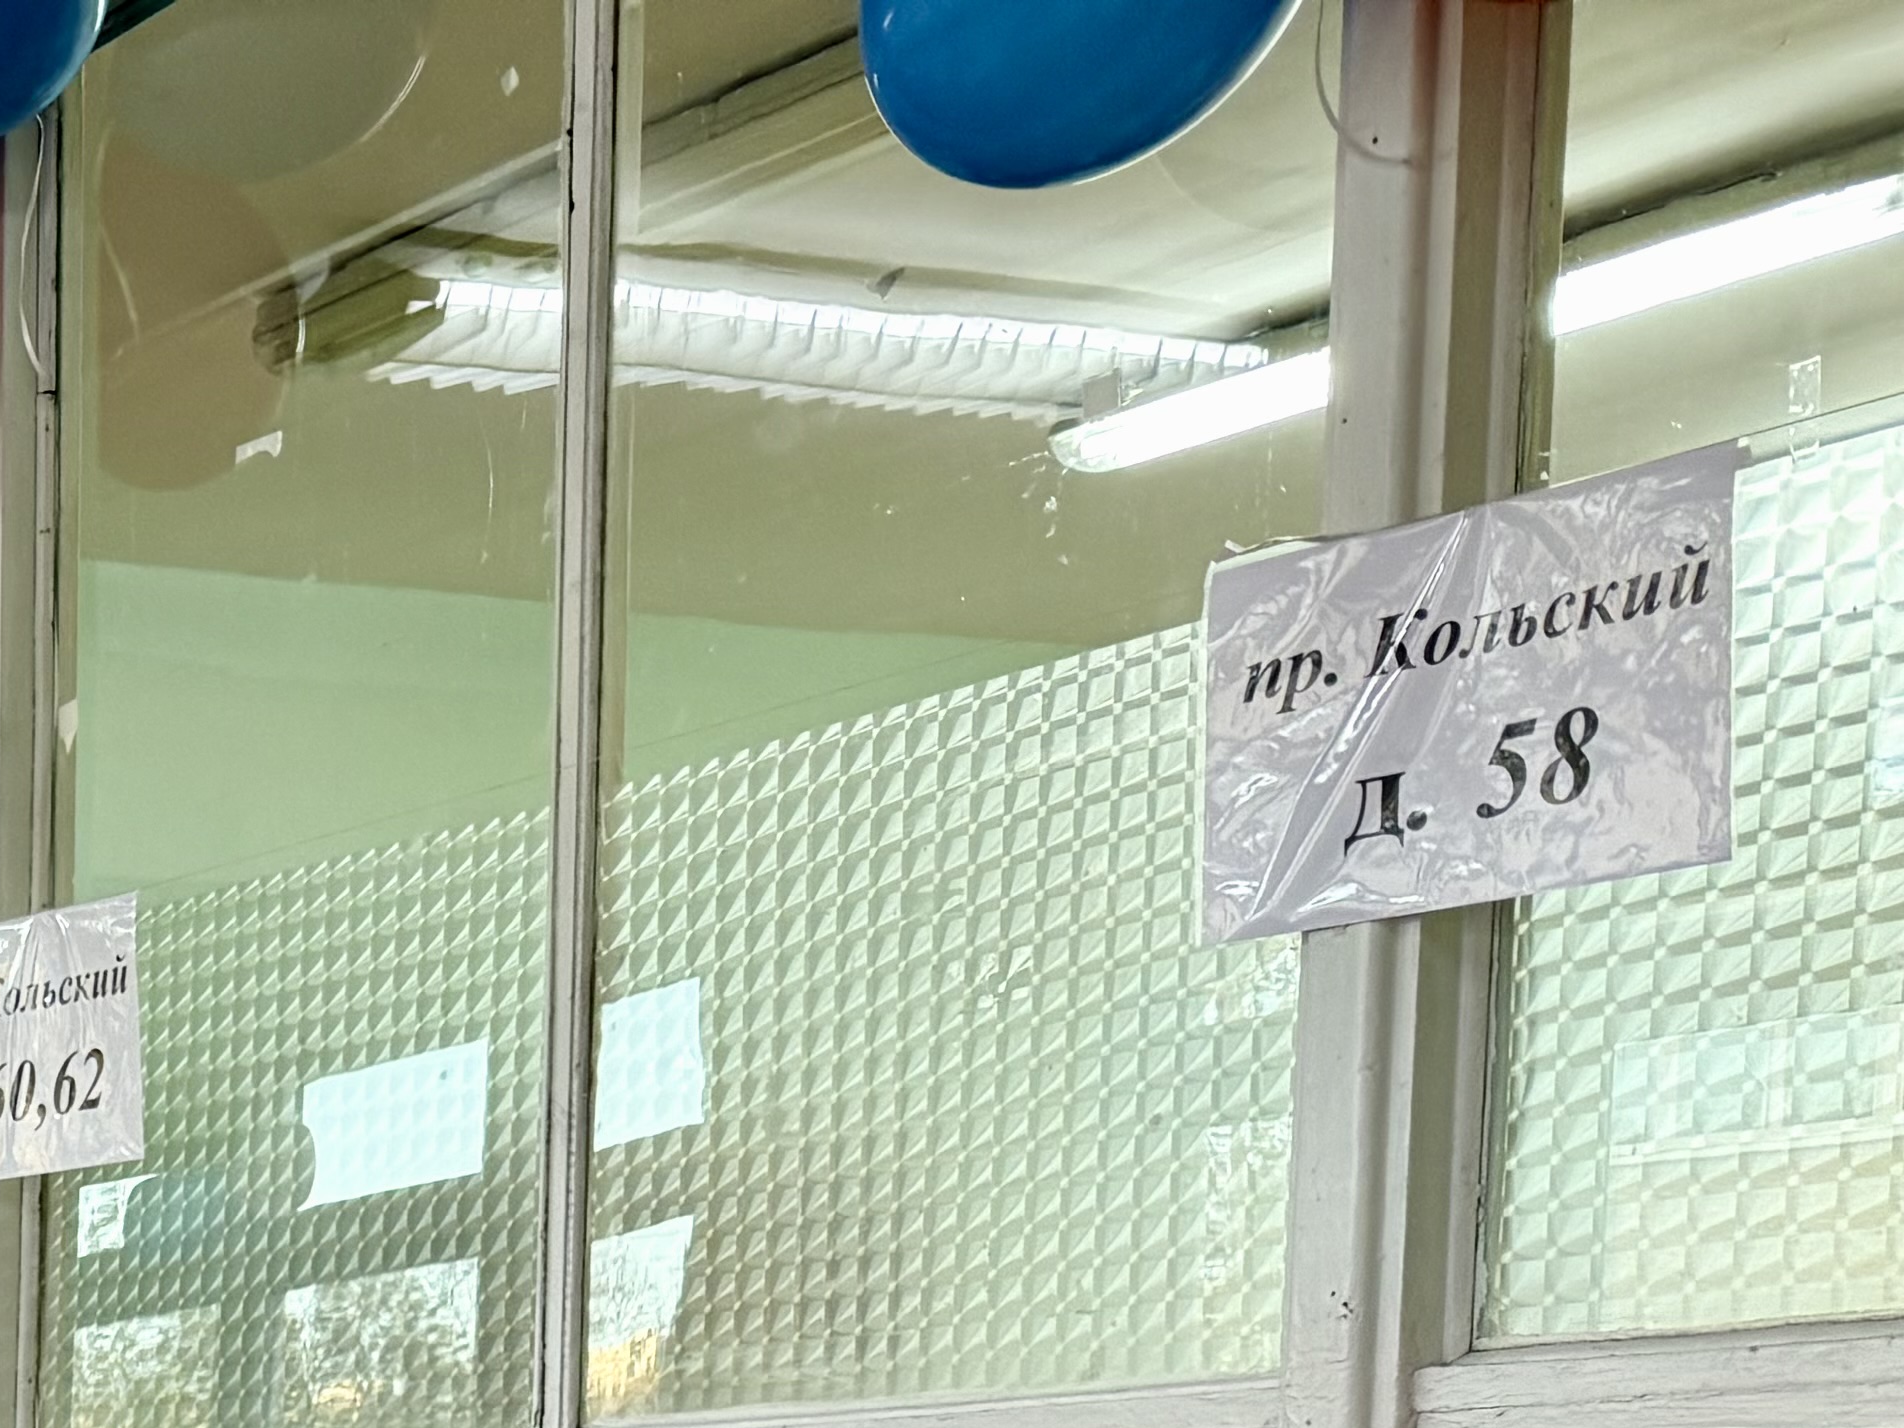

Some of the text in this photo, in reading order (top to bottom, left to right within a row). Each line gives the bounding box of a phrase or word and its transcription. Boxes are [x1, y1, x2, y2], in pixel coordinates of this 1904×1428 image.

[1242, 541, 1711, 713] пр. Кольский
[1476, 706, 1599, 819] 58
